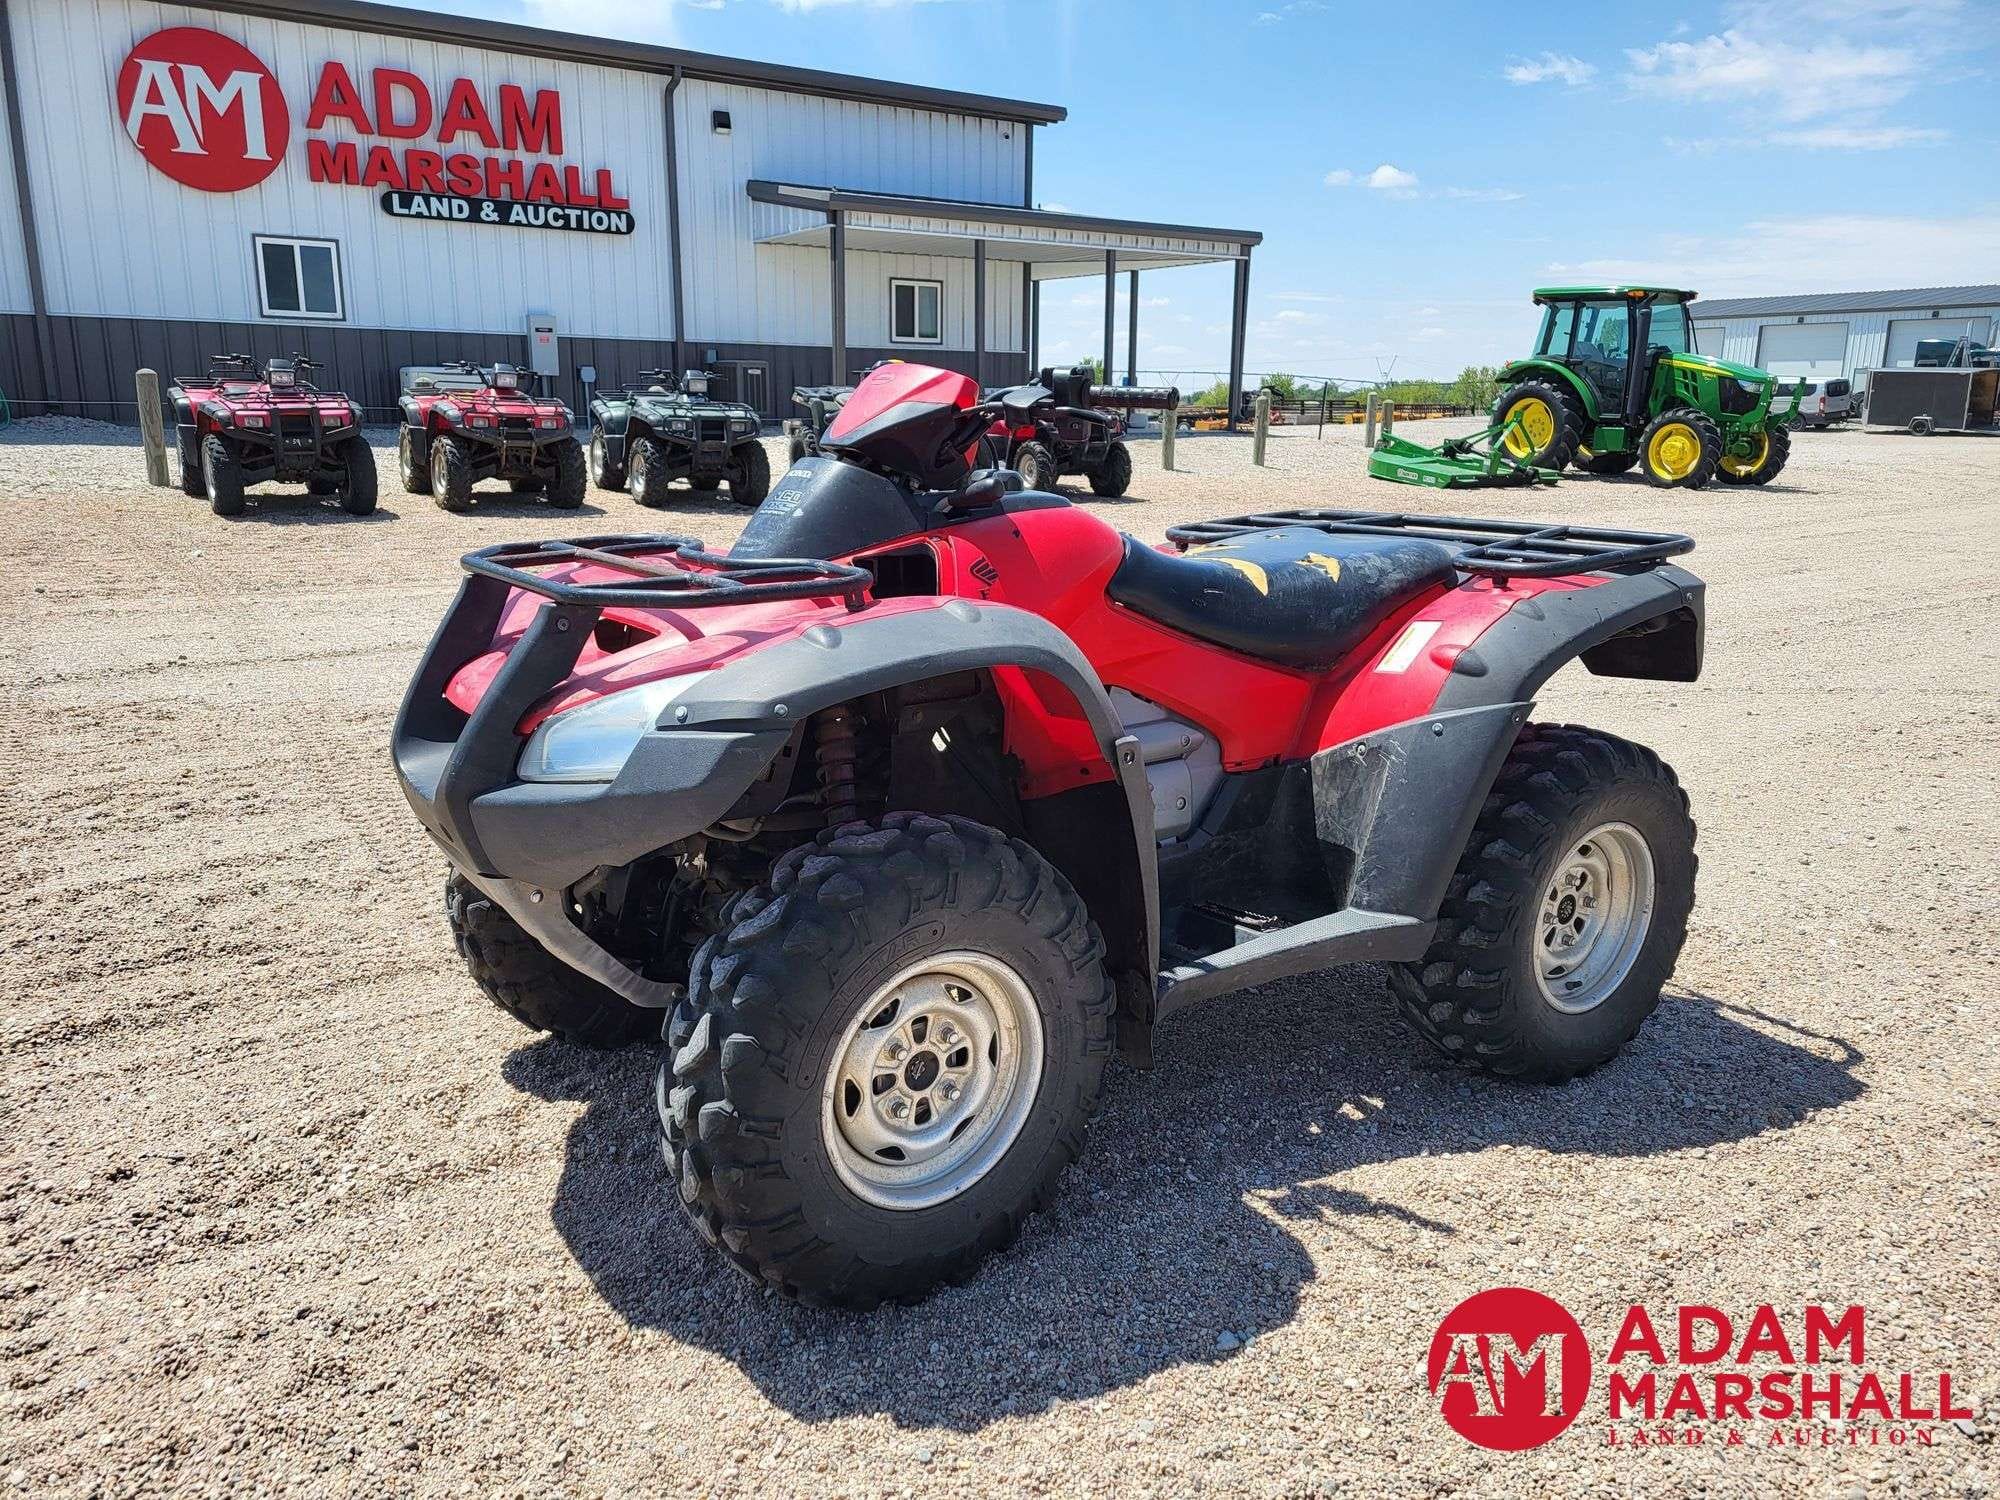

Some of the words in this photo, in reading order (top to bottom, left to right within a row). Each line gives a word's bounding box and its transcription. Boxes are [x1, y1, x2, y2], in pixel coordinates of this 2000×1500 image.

[306, 61, 563, 155] ADAM
[307, 139, 630, 210] MARSHALL
[391, 193, 470, 219] LAND
[480, 201, 500, 222] &
[508, 204, 628, 232] AUCTION
